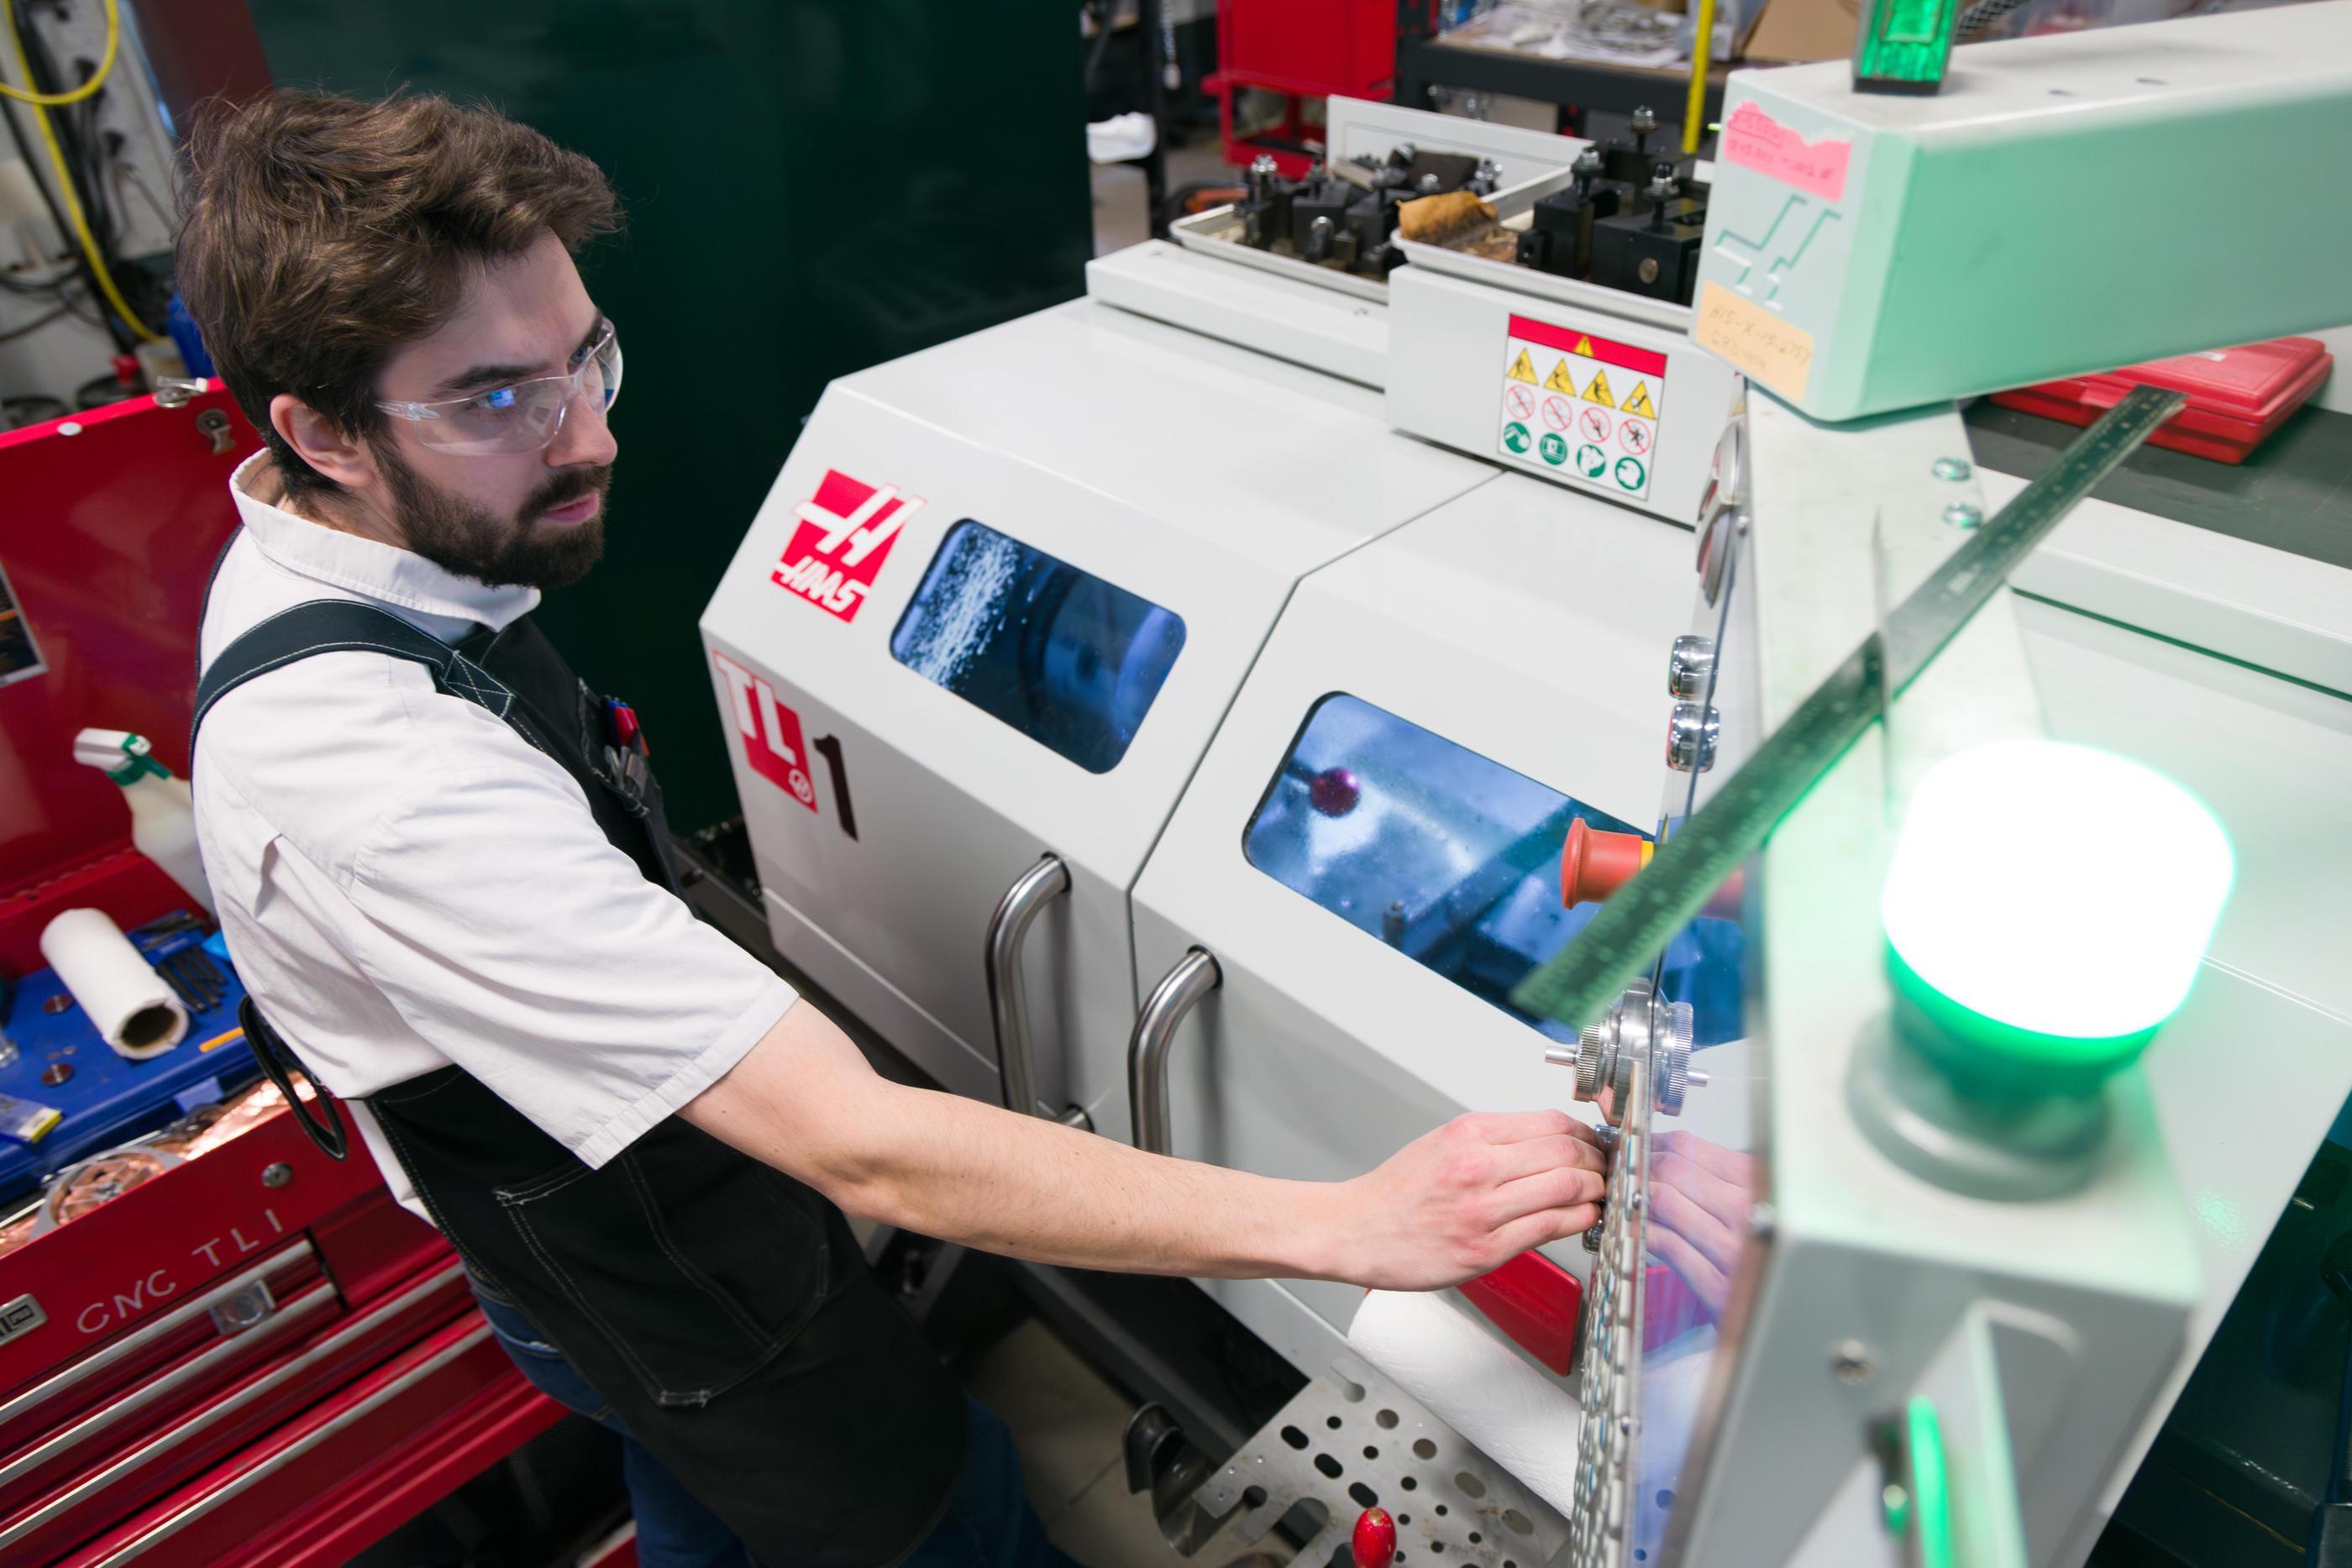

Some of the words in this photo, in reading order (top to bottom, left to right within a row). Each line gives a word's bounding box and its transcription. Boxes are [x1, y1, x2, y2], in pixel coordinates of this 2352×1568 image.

[773, 555, 872, 613] HAAS
[714, 652, 797, 766] TL
[811, 733, 858, 842] 1
[76, 1269, 176, 1334] CNC
